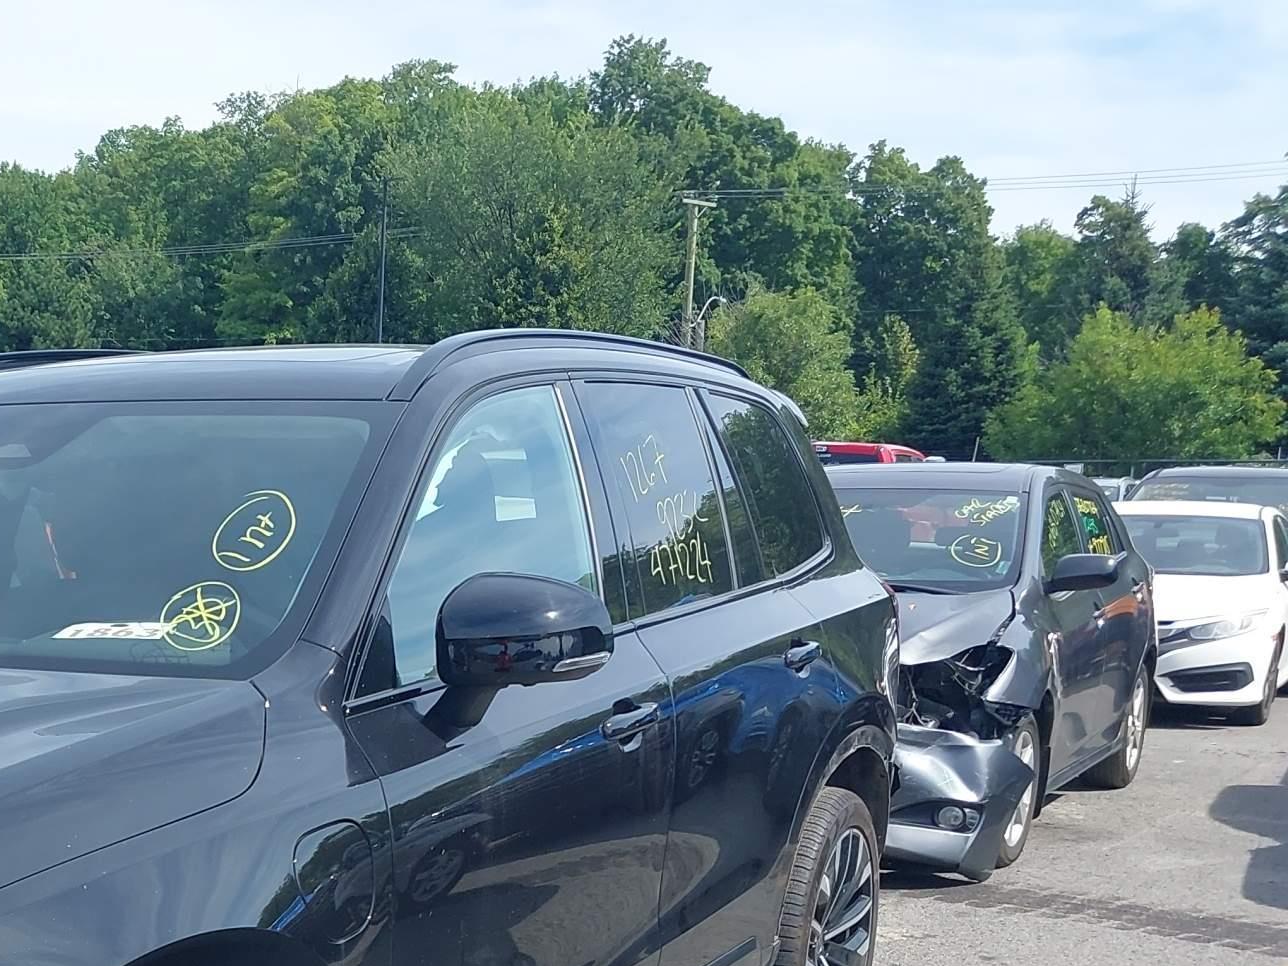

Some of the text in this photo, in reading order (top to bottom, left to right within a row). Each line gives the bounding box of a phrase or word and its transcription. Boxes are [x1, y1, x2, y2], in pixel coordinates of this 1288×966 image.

[619, 434, 668, 503] 1267
[650, 531, 714, 584] 471224
[68, 627, 159, 639] 1863
